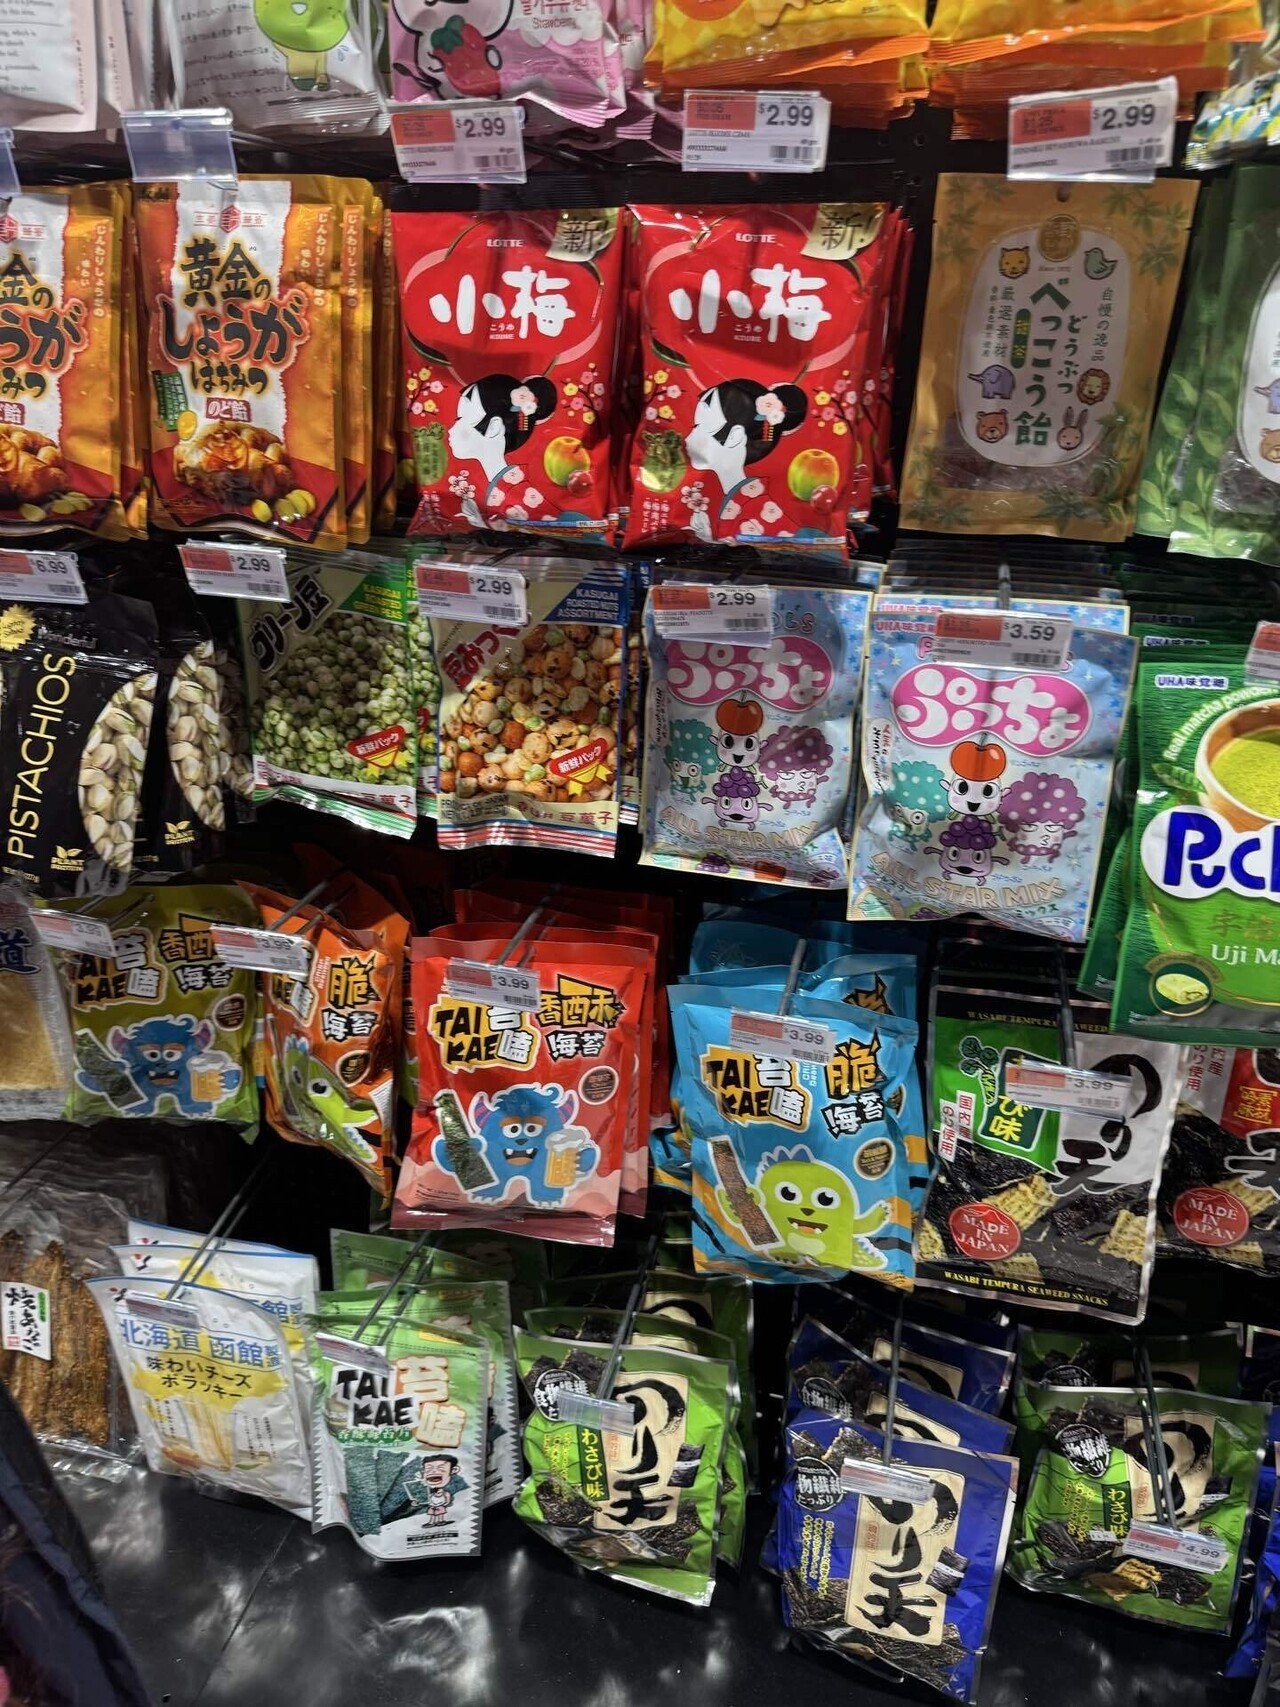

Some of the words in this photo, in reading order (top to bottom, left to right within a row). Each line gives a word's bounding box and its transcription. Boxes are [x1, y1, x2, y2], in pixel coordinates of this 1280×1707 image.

[456, 117, 506, 138] $2.99
[758, 103, 814, 126] $2.99
[1093, 103, 1156, 130] $2.99
[487, 239, 523, 248] LOTTE
[735, 233, 776, 243] LOTTE
[181, 237, 271, 307] 黄金の
[429, 265, 575, 338] 小梅
[668, 263, 832, 343] 小梅
[161, 296, 308, 361] しょうが
[1013, 277, 1071, 447] べっこう飴
[1057, 314, 1088, 394] どうぶつ
[191, 359, 268, 395] はちみつ
[207, 400, 248, 421] のど飴
[469, 576, 513, 596] $2.99
[709, 592, 755, 606] $2.99
[1004, 622, 1056, 641] $3.59
[898, 667, 1084, 748] ぷっちょ
[8, 653, 76, 858] PISTACHIOS
[705, 825, 770, 851] STAR
[925, 876, 1000, 909] STAR
[1003, 877, 1067, 909] MIX
[1211, 944, 1247, 965] Uji
[175, 963, 233, 995] 海苔
[322, 1010, 376, 1041] 海苔
[435, 1007, 483, 1038] TAI
[1073, 1022, 1108, 1033] AWEED
[446, 1033, 501, 1064] KAE
[547, 1032, 605, 1059] 海苔
[706, 1057, 751, 1089] TAI
[829, 1037, 883, 1098] 脆
[721, 1091, 771, 1118] KAE
[1188, 1199, 1238, 1220] MADE
[1201, 1214, 1219, 1227] IN
[962, 1217, 1009, 1236] MADE
[976, 1229, 993, 1243] IN
[1181, 1218, 1235, 1241] JAPAN
[957, 1233, 1010, 1254] JAPAN
[944, 1271, 981, 1285] WASABI
[981, 1276, 1027, 1294] TEMPURA
[1027, 1284, 1072, 1299] SEAWEED
[1072, 1291, 1109, 1306] SNACKS
[120, 1318, 200, 1353] 北海道
[209, 1335, 264, 1368] 函館
[146, 1356, 252, 1389] 味わいチーズ
[161, 1374, 243, 1399] ボラッキー
[336, 1369, 389, 1400] TAI
[352, 1397, 414, 1428] KAE
[581, 1428, 604, 1498] わさび味
[1107, 1487, 1128, 1537] わさび味
